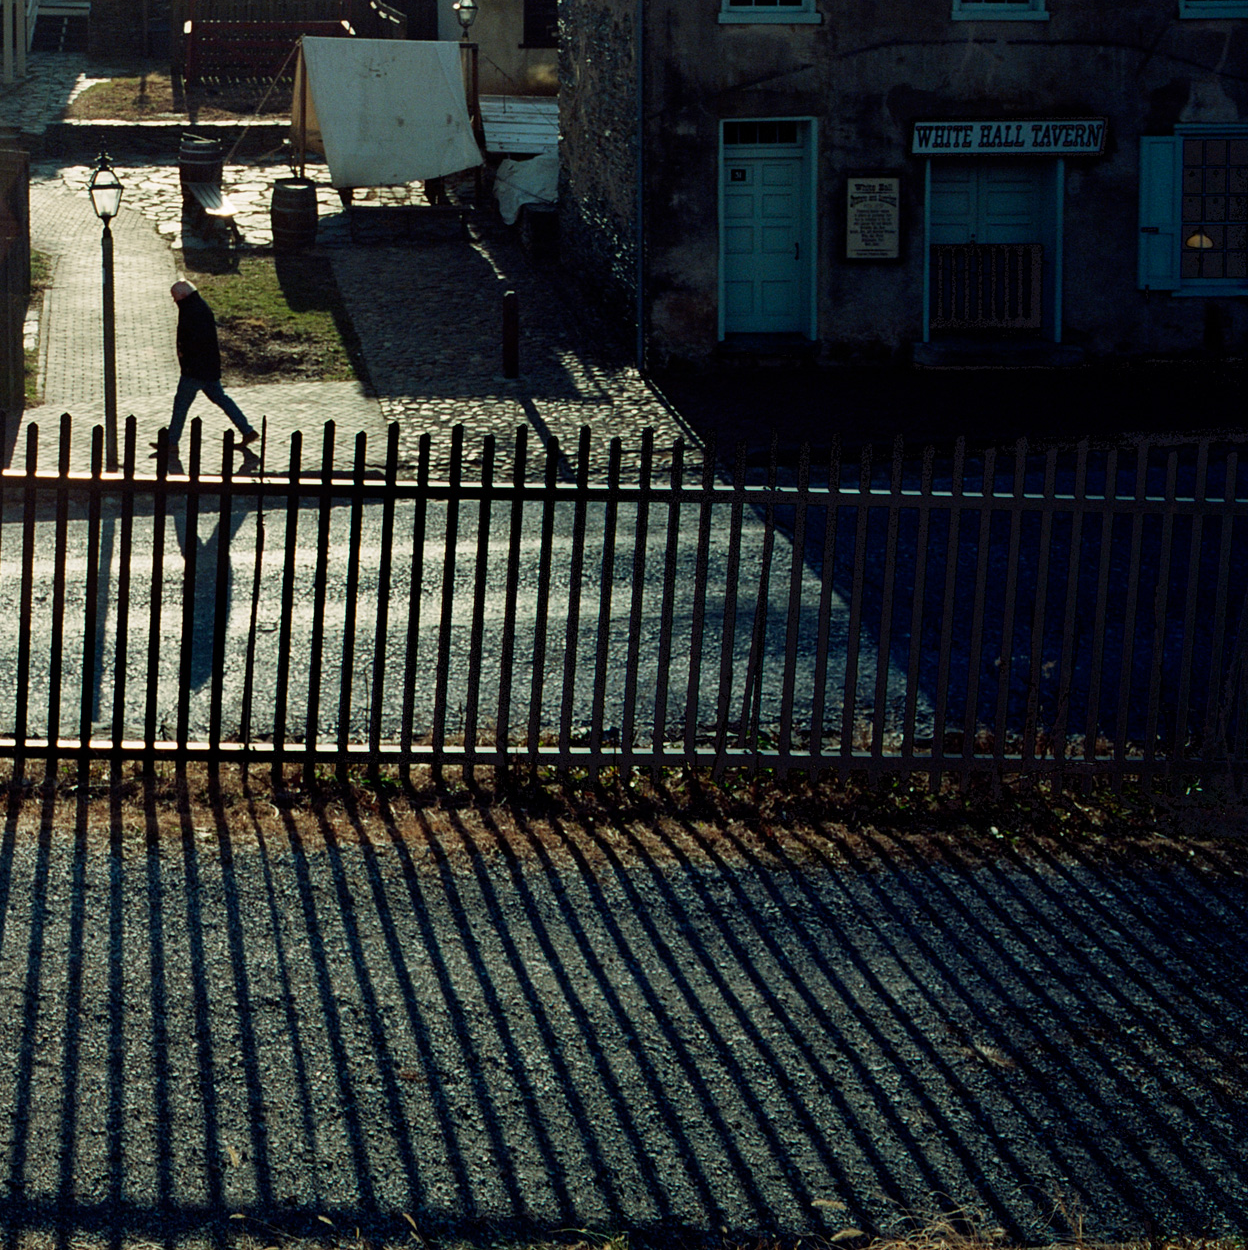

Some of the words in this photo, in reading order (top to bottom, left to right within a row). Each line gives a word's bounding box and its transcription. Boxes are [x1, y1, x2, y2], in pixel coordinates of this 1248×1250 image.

[915, 125, 973, 148] WHITE
[978, 124, 1025, 147] HALL
[1031, 124, 1102, 147] TAVERN
